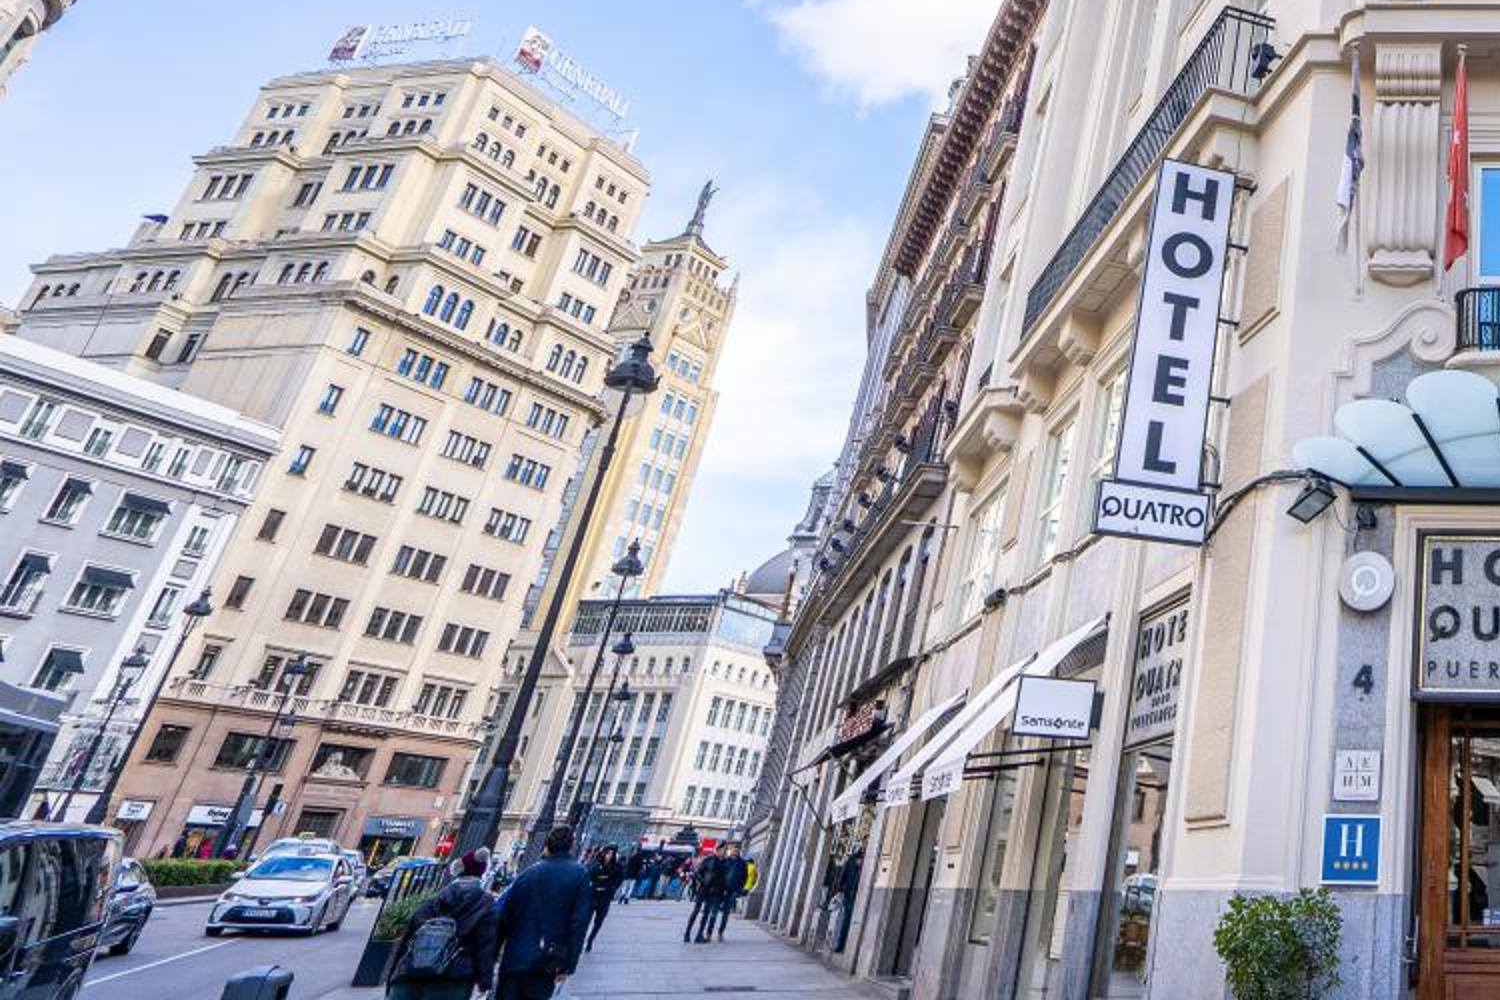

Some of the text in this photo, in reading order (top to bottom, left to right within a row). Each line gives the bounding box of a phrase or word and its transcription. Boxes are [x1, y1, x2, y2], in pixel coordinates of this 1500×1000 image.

[1142, 171, 1219, 475] HOTEL
[1102, 495, 1204, 528] QUATRO
[1140, 609, 1189, 660] HOTE
[1135, 658, 1183, 702] QUATR
[1352, 664, 1375, 696] 4
[1340, 824, 1365, 858] H
